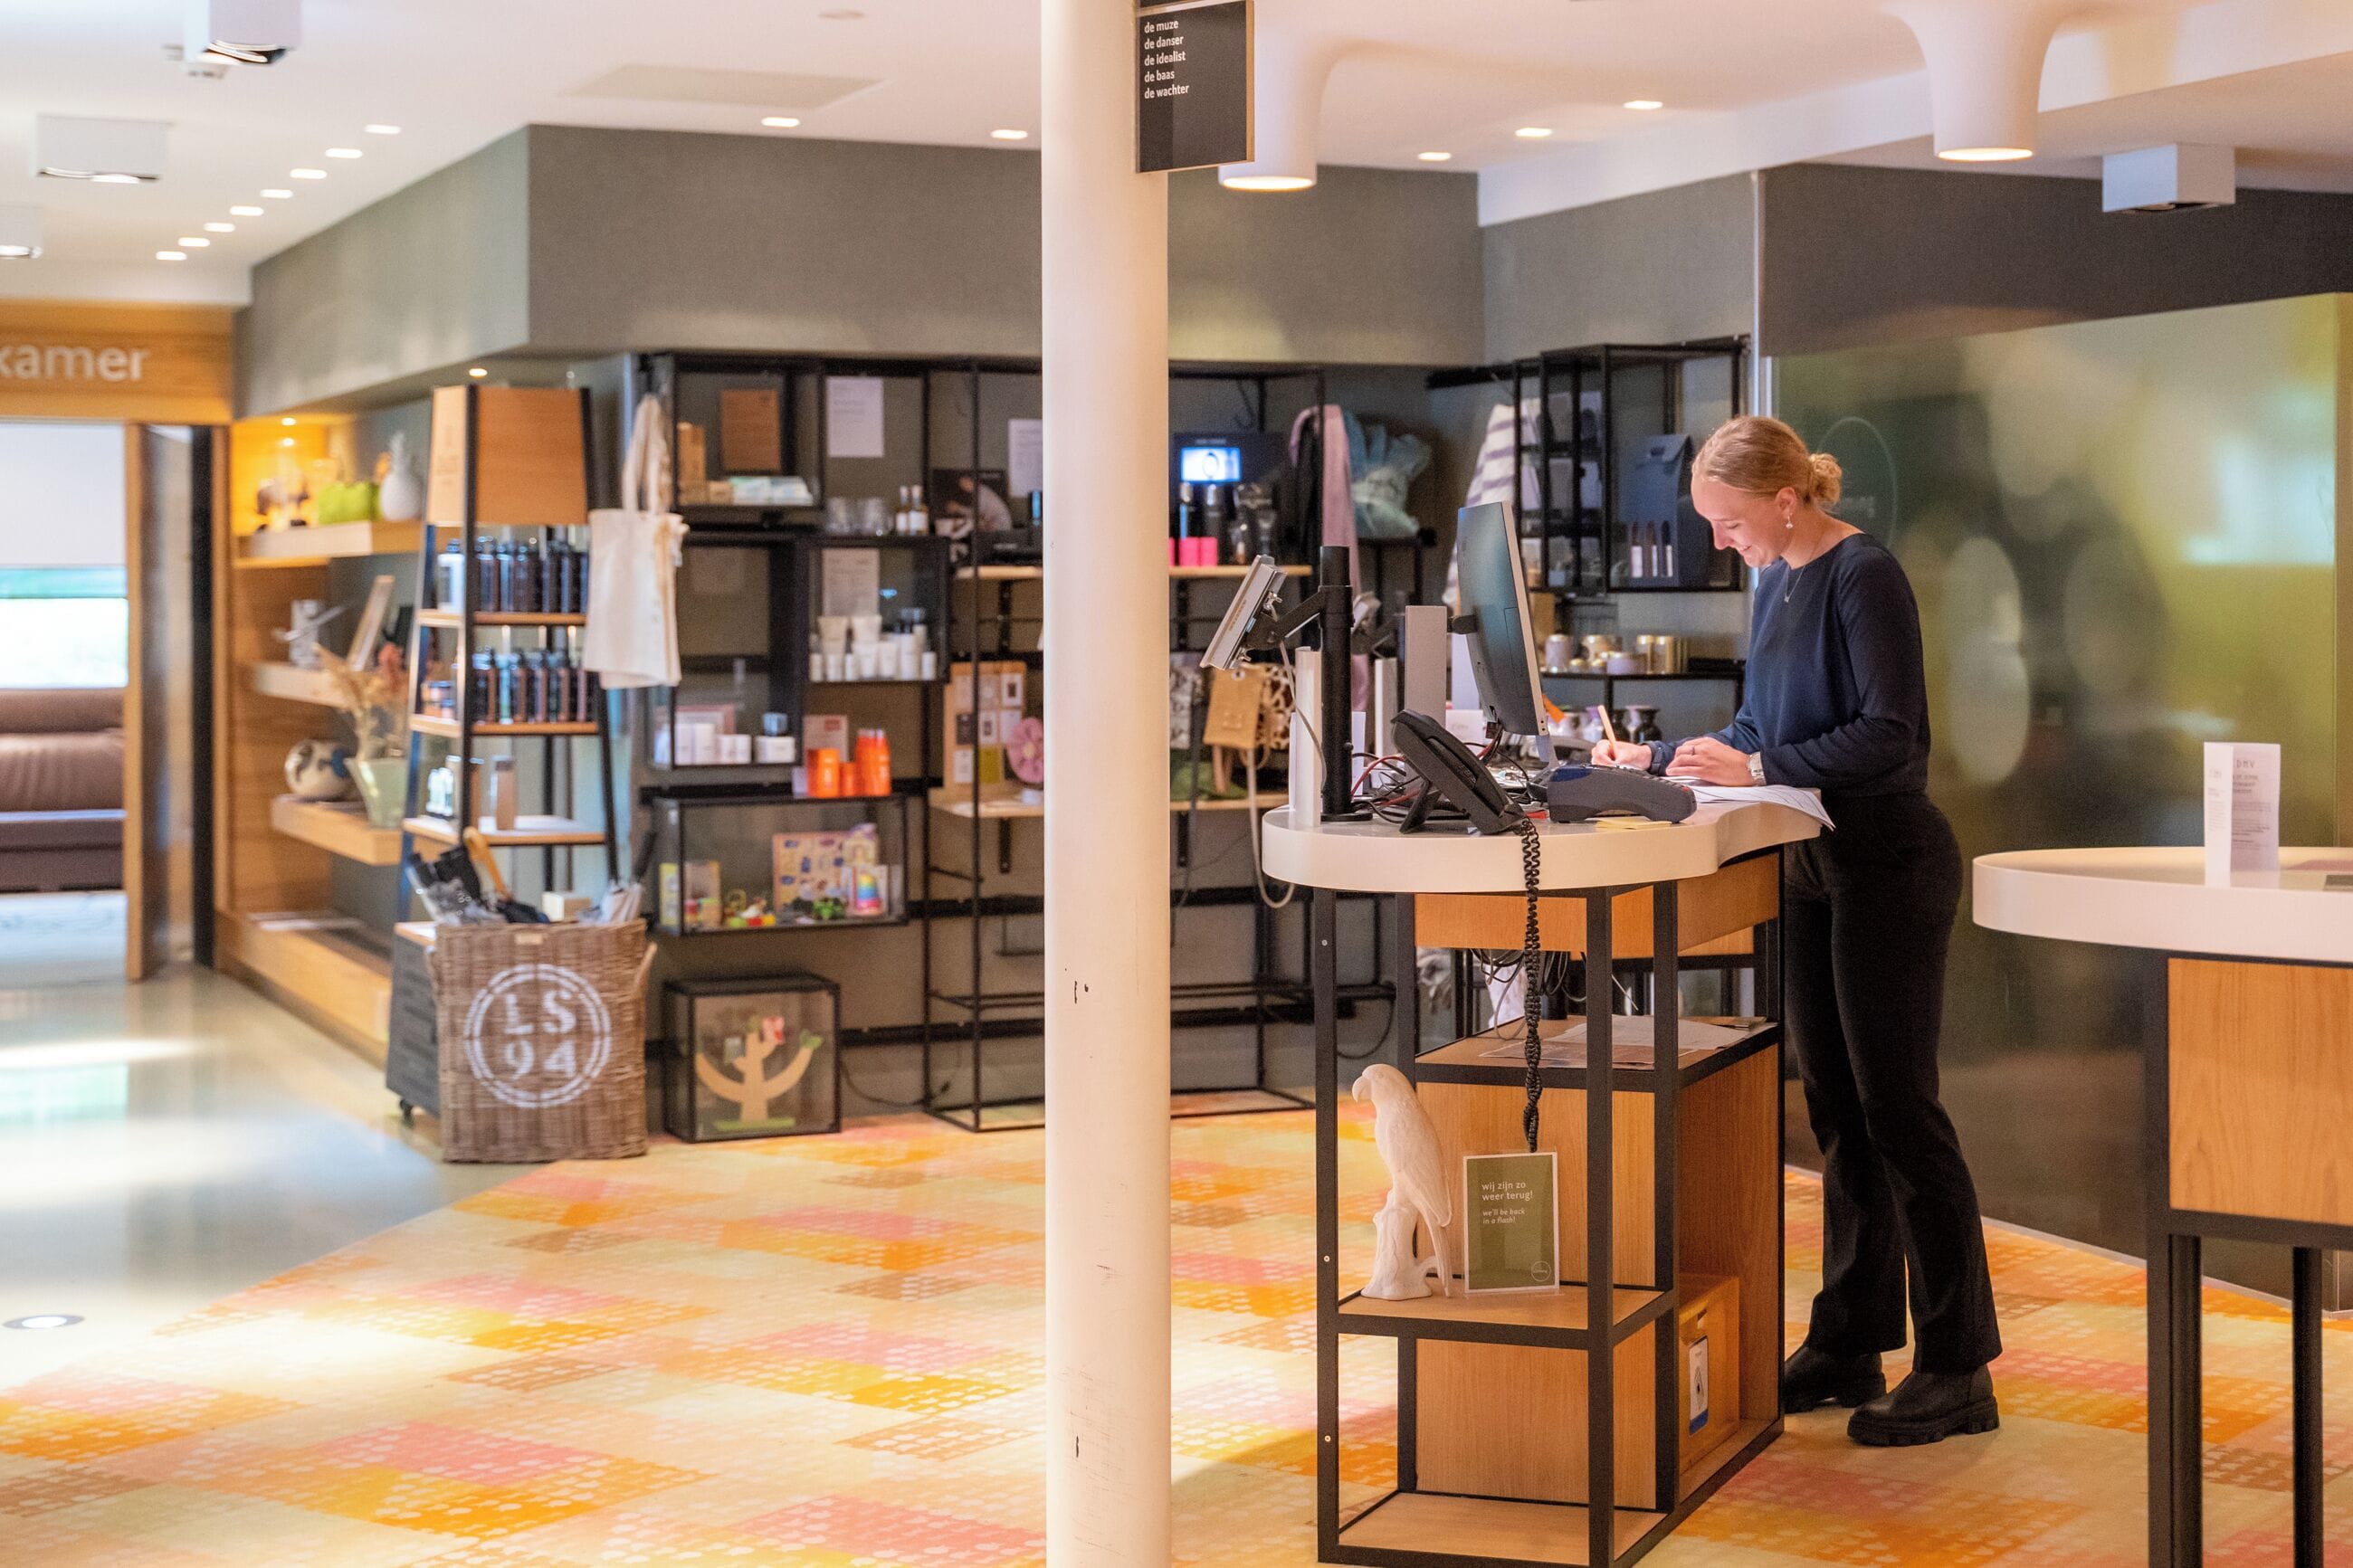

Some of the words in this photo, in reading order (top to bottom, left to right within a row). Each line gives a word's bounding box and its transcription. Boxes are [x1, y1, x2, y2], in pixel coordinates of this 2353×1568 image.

[1144, 22, 1155, 33] de
[1156, 20, 1179, 32] muze
[1144, 38, 1155, 50] de
[1156, 36, 1184, 48] danser
[1144, 54, 1155, 66] de
[1156, 51, 1186, 64] idealist
[1144, 71, 1155, 83] de
[1156, 70, 1175, 81] baas
[1144, 87, 1155, 100] de
[1156, 84, 1189, 98] wachter
[504, 990, 576, 1035] LS
[504, 1040, 576, 1082] 94
[1481, 1181, 1495, 1193] wij
[1497, 1181, 1513, 1192] zijn
[1481, 1193, 1504, 1202] weer
[1506, 1190, 1533, 1202] terug!
[1510, 1207, 1526, 1215] back
[1497, 1215, 1516, 1224] flash!
